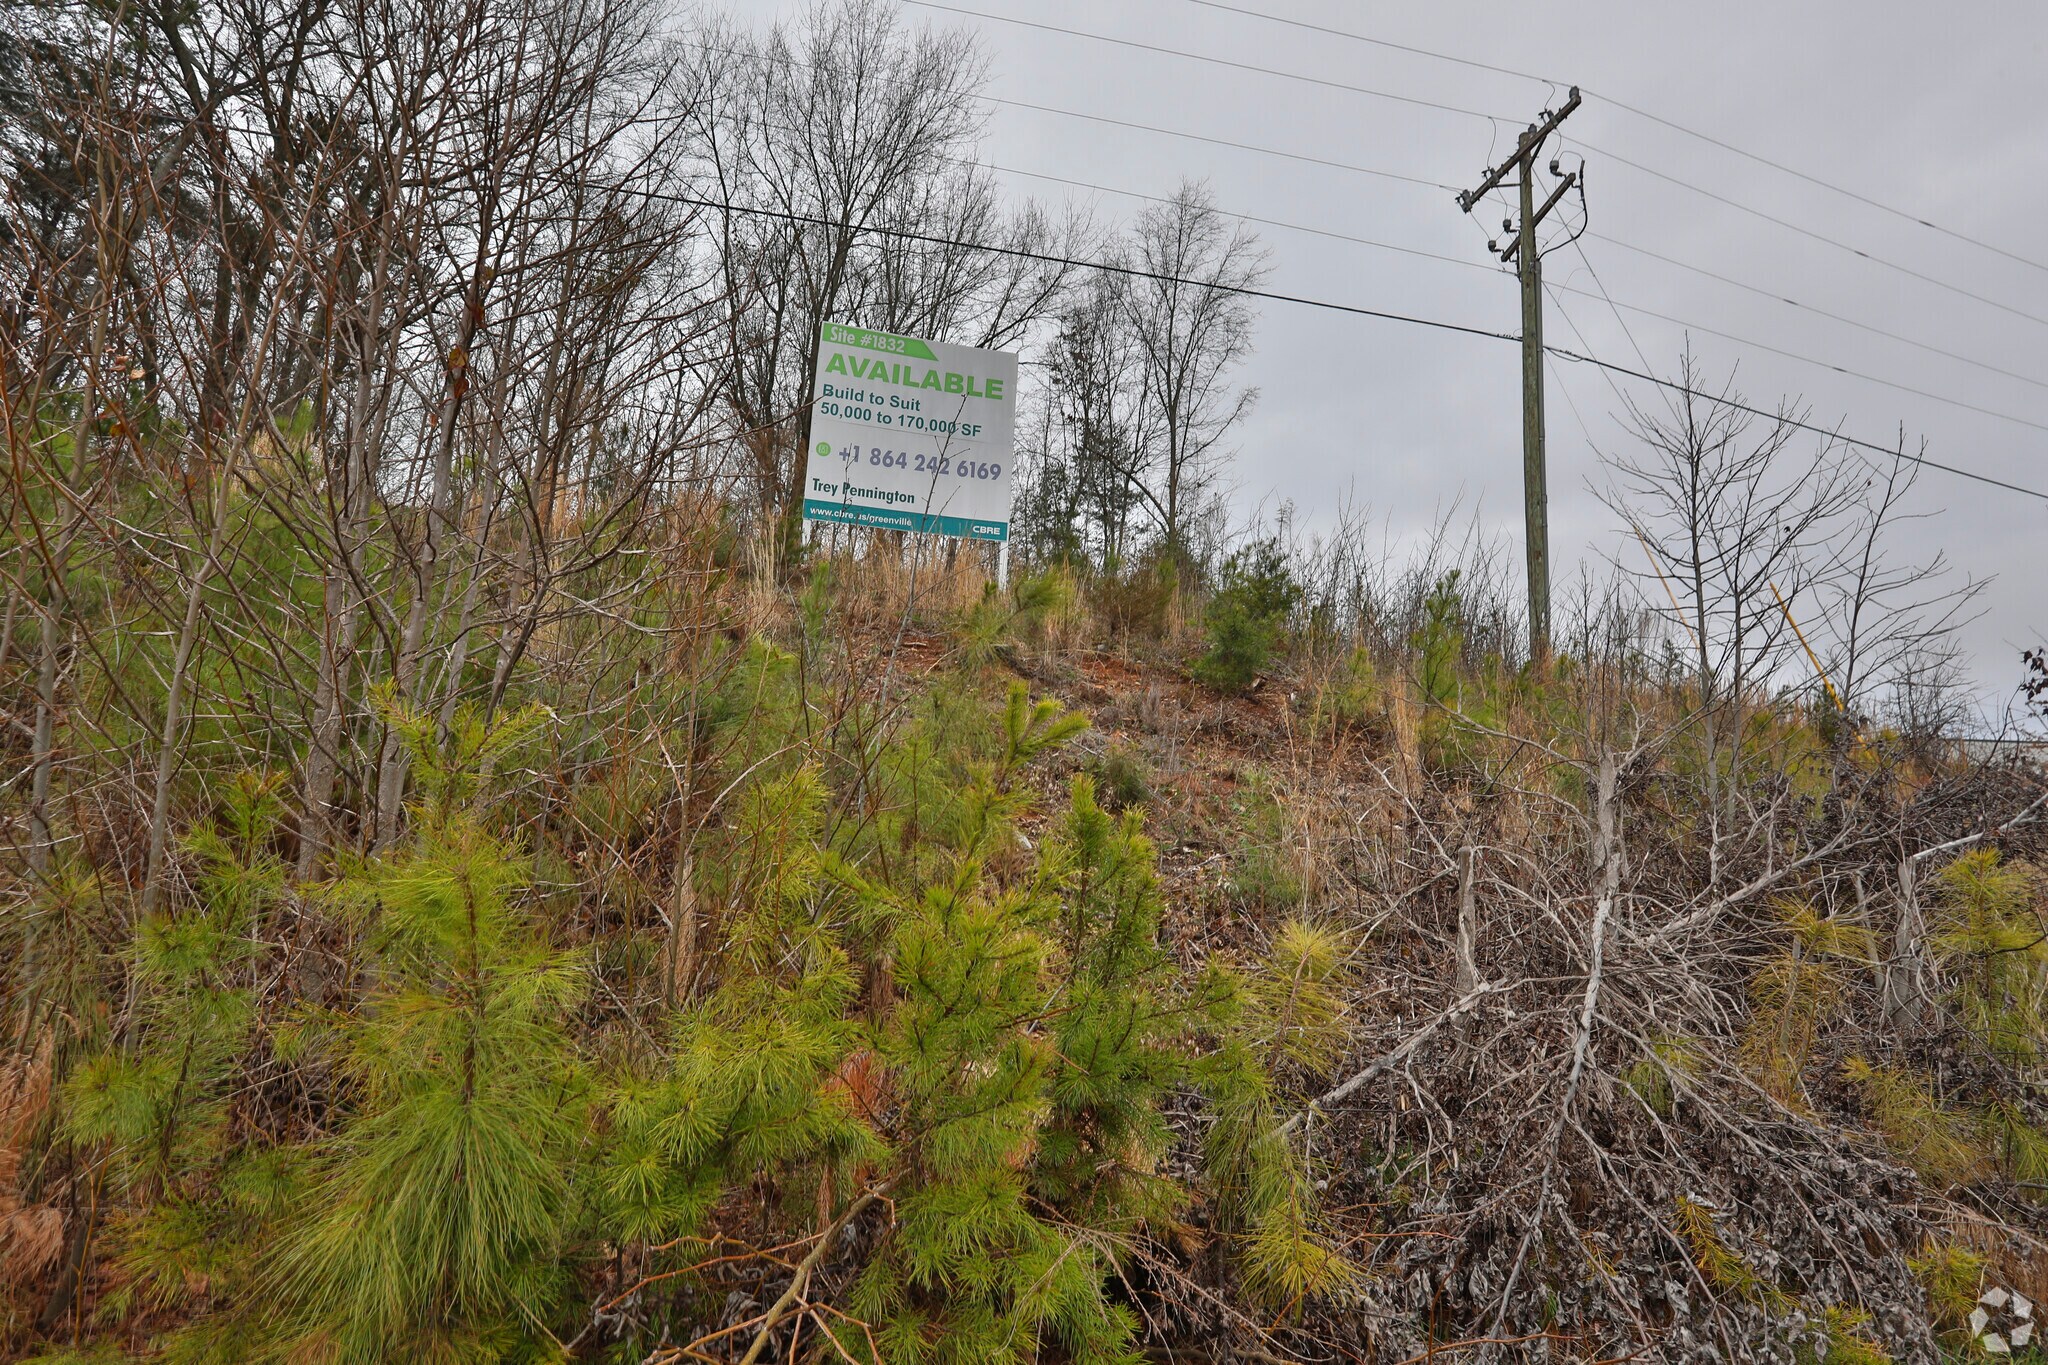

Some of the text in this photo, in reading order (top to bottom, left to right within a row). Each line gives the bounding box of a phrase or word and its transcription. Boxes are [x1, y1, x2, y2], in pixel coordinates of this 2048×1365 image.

[830, 326, 905, 353] Site #1832
[825, 353, 1004, 400] AVAILABLE
[823, 383, 920, 411] Build to Suit
[821, 402, 981, 437] 50,000 to 170,000 SF
[839, 445, 1001, 480] +1 864 242 6169
[812, 478, 915, 504] Trey Pennington
[972, 525, 1000, 535] CBRE
